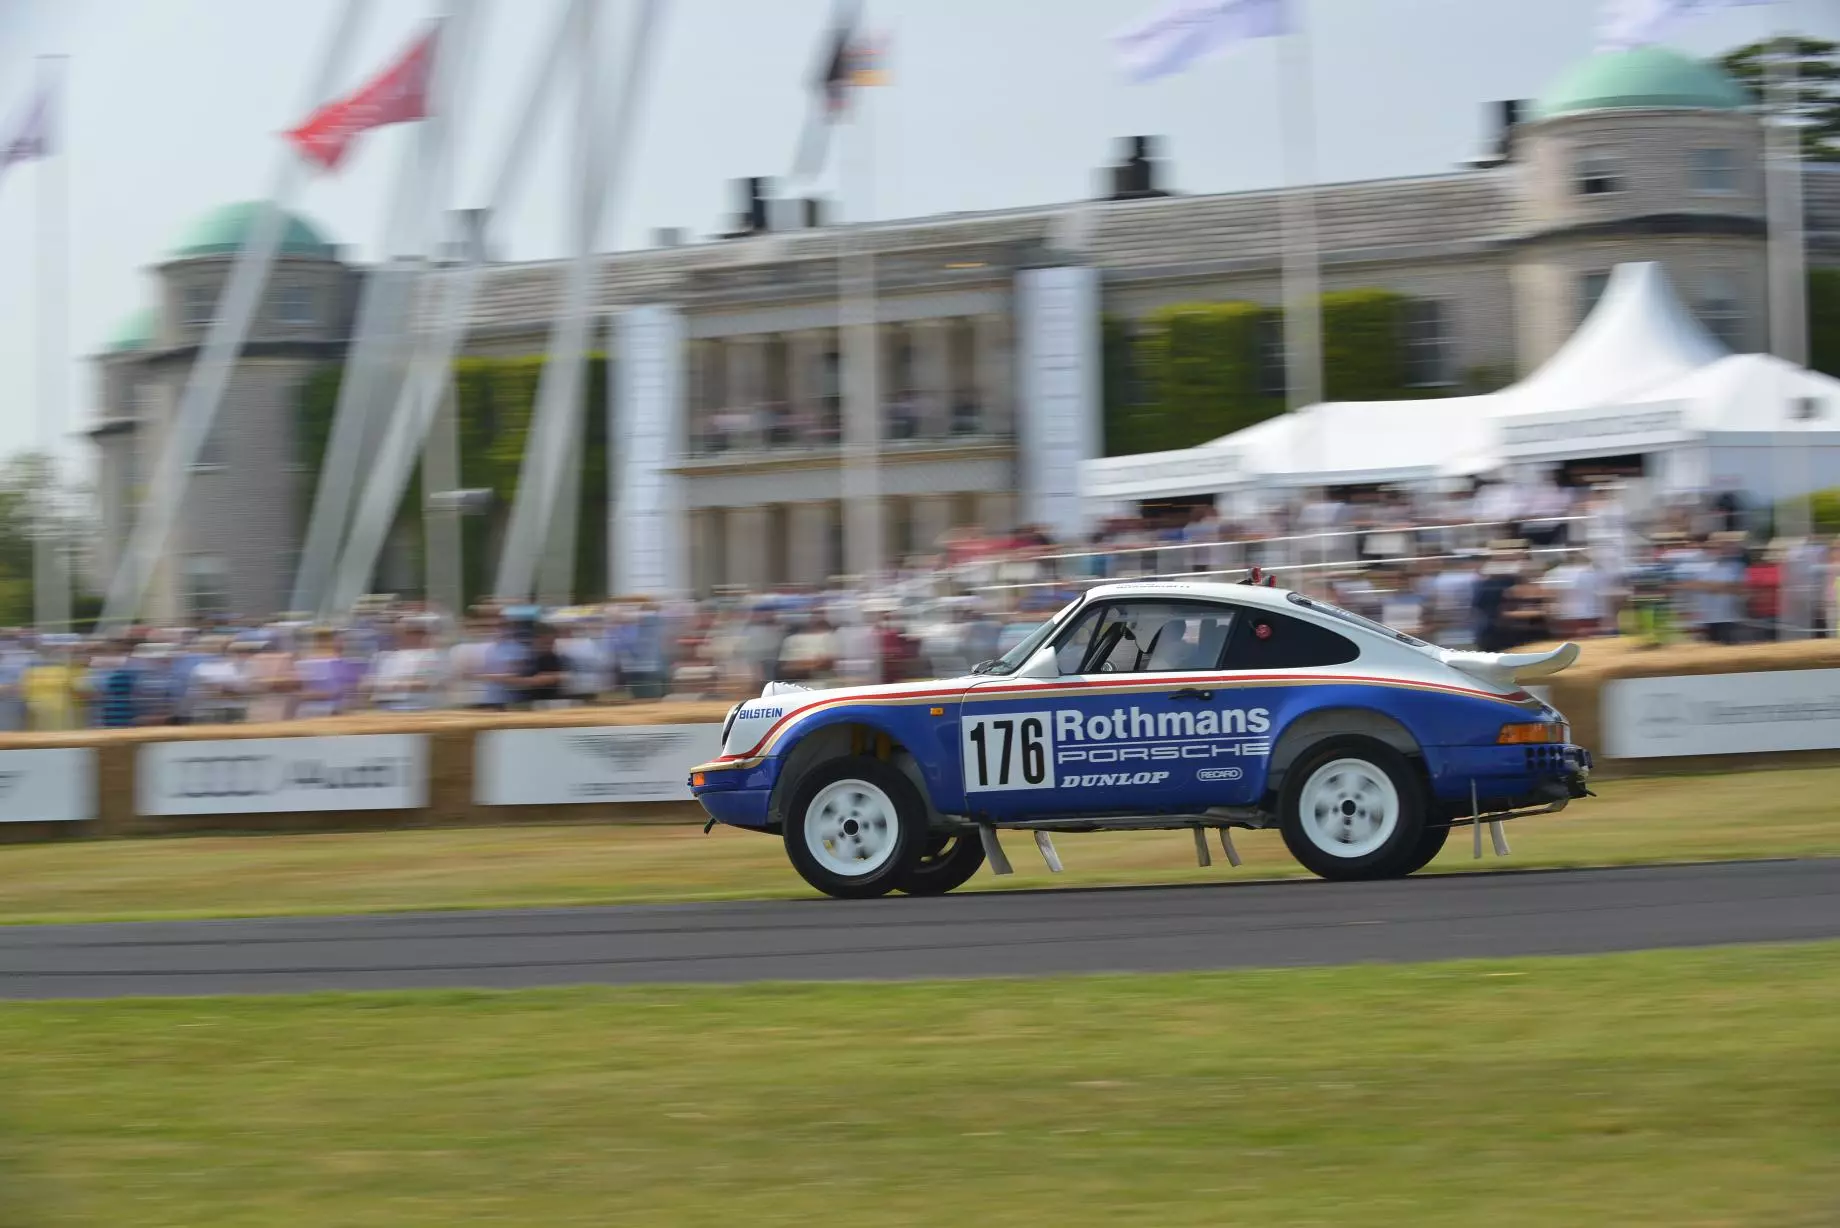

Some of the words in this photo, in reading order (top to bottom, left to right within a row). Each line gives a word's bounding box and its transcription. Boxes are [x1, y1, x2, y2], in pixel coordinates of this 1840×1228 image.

[739, 708, 783, 720] BILSTEIN
[1056, 706, 1270, 741] Rothmans
[970, 717, 1045, 786] 176
[1058, 742, 1270, 764] PORSCHE
[1061, 771, 1170, 788] DUNLOP
[1200, 770, 1239, 779] RECARO
